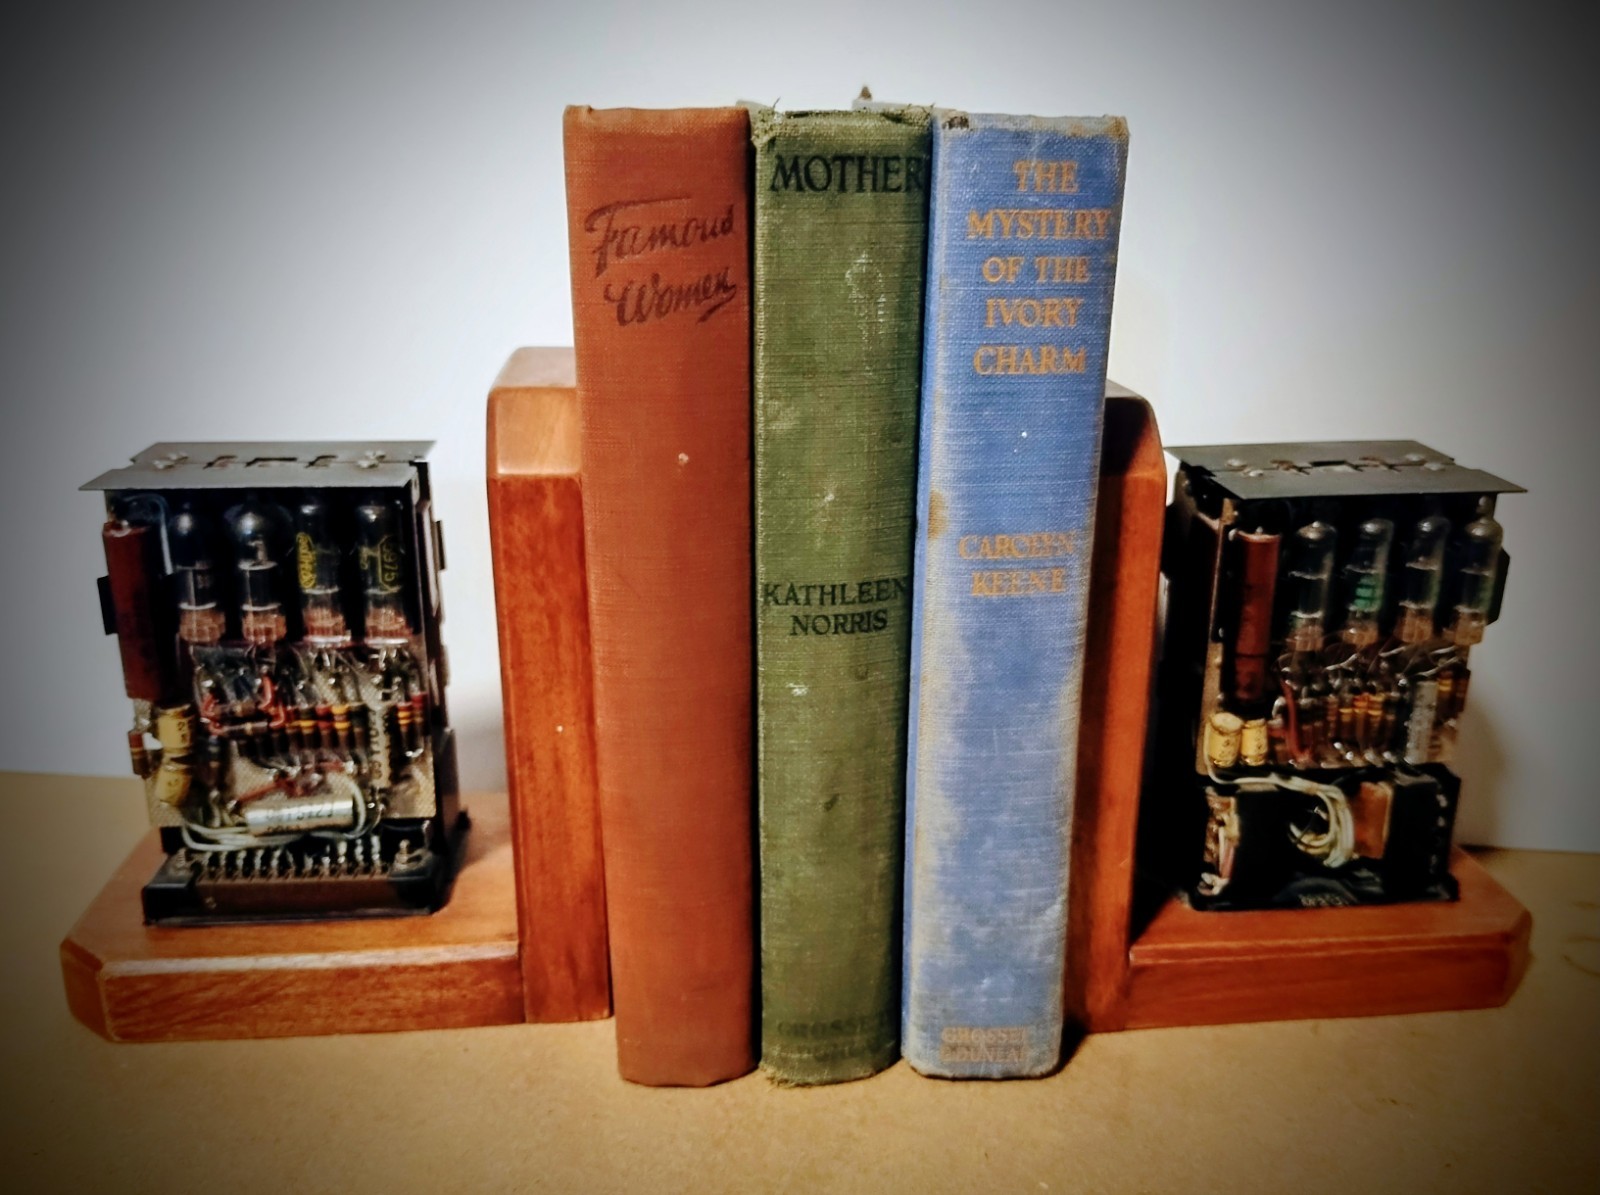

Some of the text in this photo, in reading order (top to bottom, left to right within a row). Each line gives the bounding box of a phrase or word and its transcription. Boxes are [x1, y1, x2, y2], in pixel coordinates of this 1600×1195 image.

[770, 155, 927, 193] MOTHER
[1013, 160, 1079, 193] THE
[585, 194, 734, 278] Famous
[966, 207, 1112, 239] MYSTERY
[982, 256, 1090, 283] OF THE
[603, 267, 736, 327] Women
[984, 298, 1084, 328] IVORY
[973, 345, 1087, 375] CHARM
[762, 576, 909, 607] KATHLEEN
[971, 567, 1066, 596] KEENE
[789, 609, 888, 636] NORRIS
